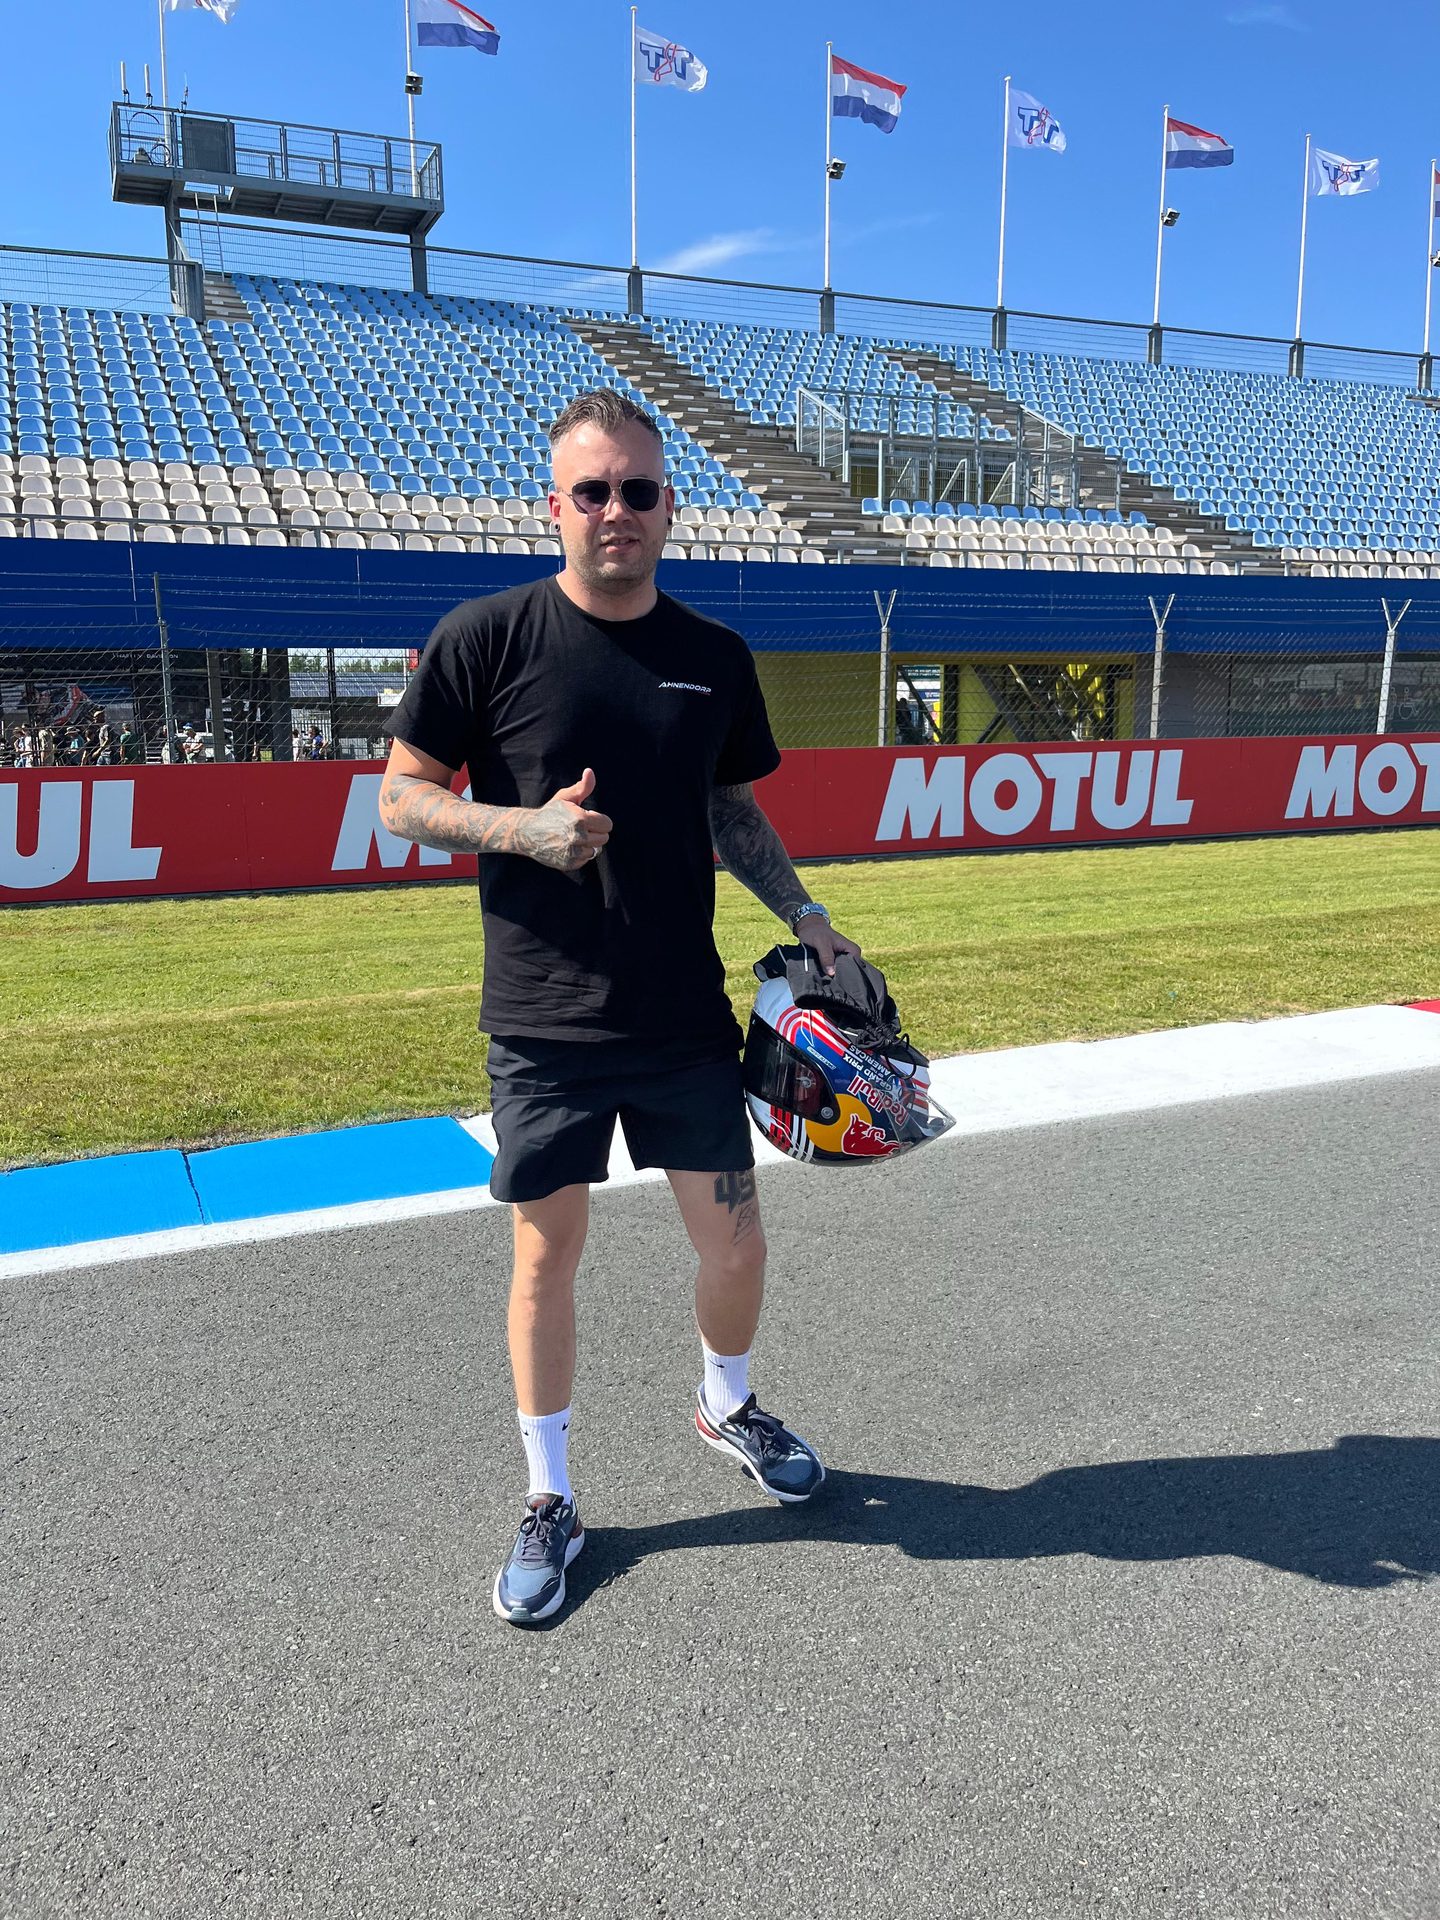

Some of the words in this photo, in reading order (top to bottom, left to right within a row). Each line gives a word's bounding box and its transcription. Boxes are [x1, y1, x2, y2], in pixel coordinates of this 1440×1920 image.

[874, 749, 1194, 841] MOTUL
[843, 1053, 864, 1071] PRIX
[849, 1045, 892, 1076] AMERICAS
[863, 1068, 893, 1091] GRAND
